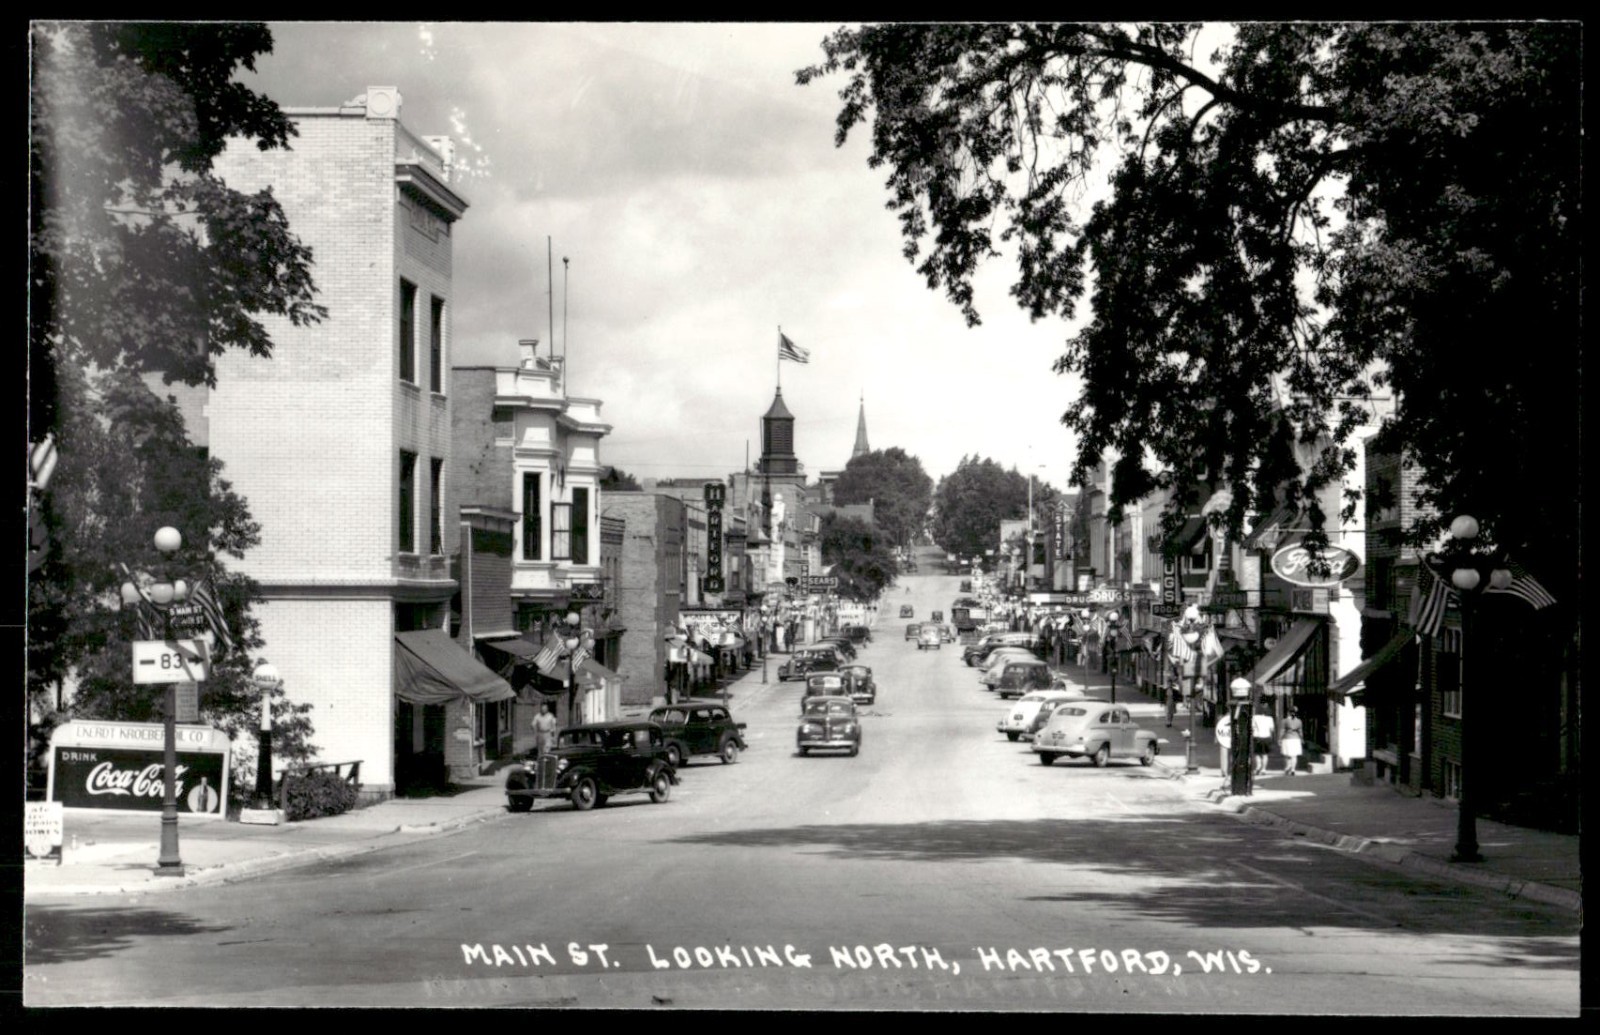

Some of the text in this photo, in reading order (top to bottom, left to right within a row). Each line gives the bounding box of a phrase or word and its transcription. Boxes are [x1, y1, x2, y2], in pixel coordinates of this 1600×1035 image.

[1282, 548, 1354, 575] Fd
[809, 577, 835, 585] SEARS
[1164, 562, 1175, 602] UGS
[1094, 591, 1131, 602] DRUGS
[161, 653, 183, 669] 83
[61, 751, 98, 761] DRINK
